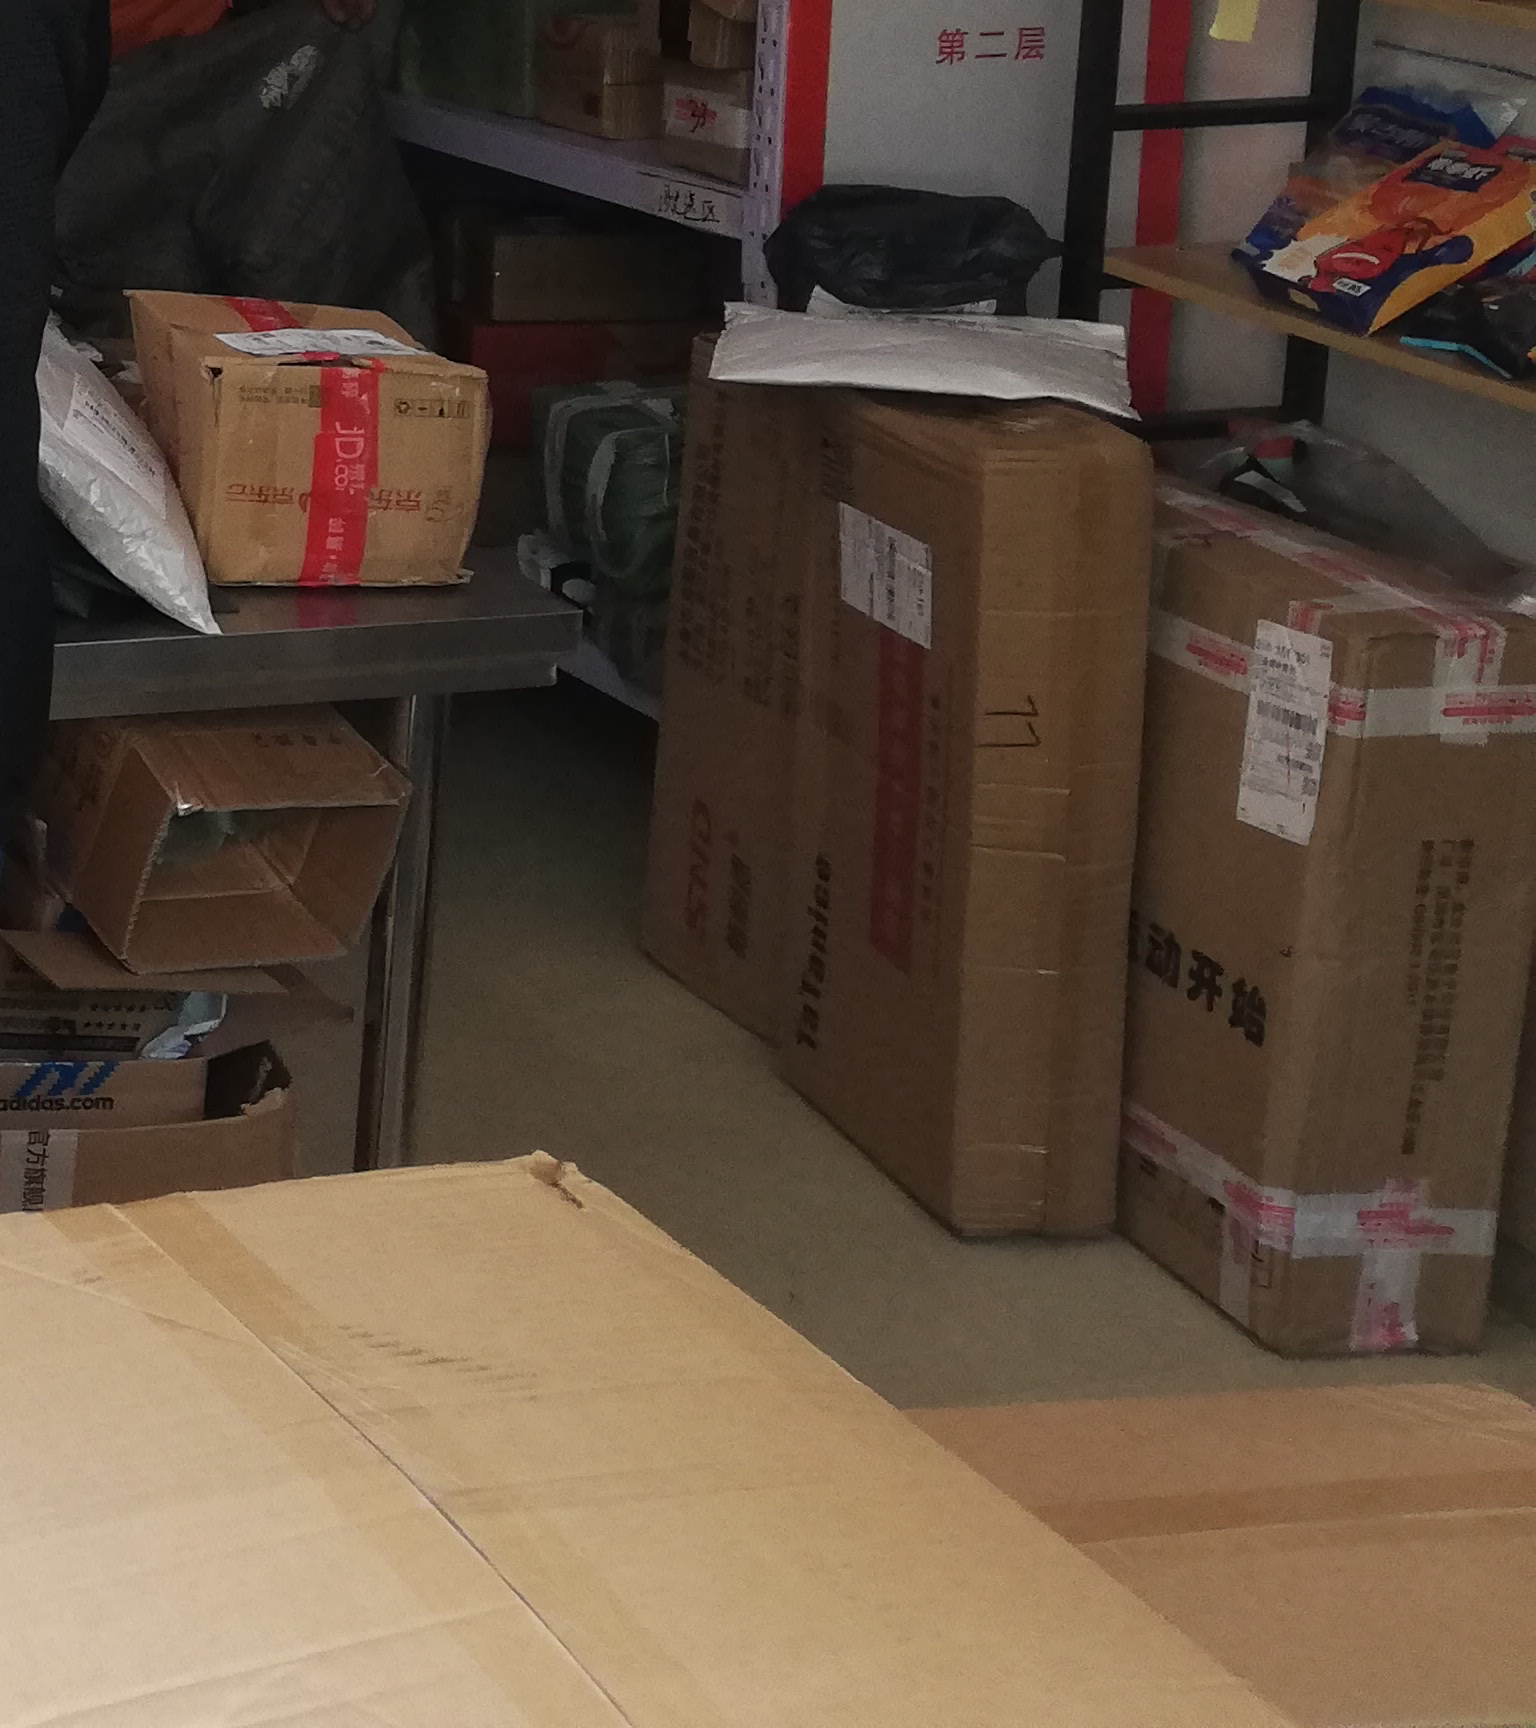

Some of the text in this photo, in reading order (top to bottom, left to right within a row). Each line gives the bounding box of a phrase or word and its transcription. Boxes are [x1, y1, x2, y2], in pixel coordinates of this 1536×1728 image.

[935, 26, 1047, 66] 第二层
[1129, 909, 1268, 1048] 动开始
